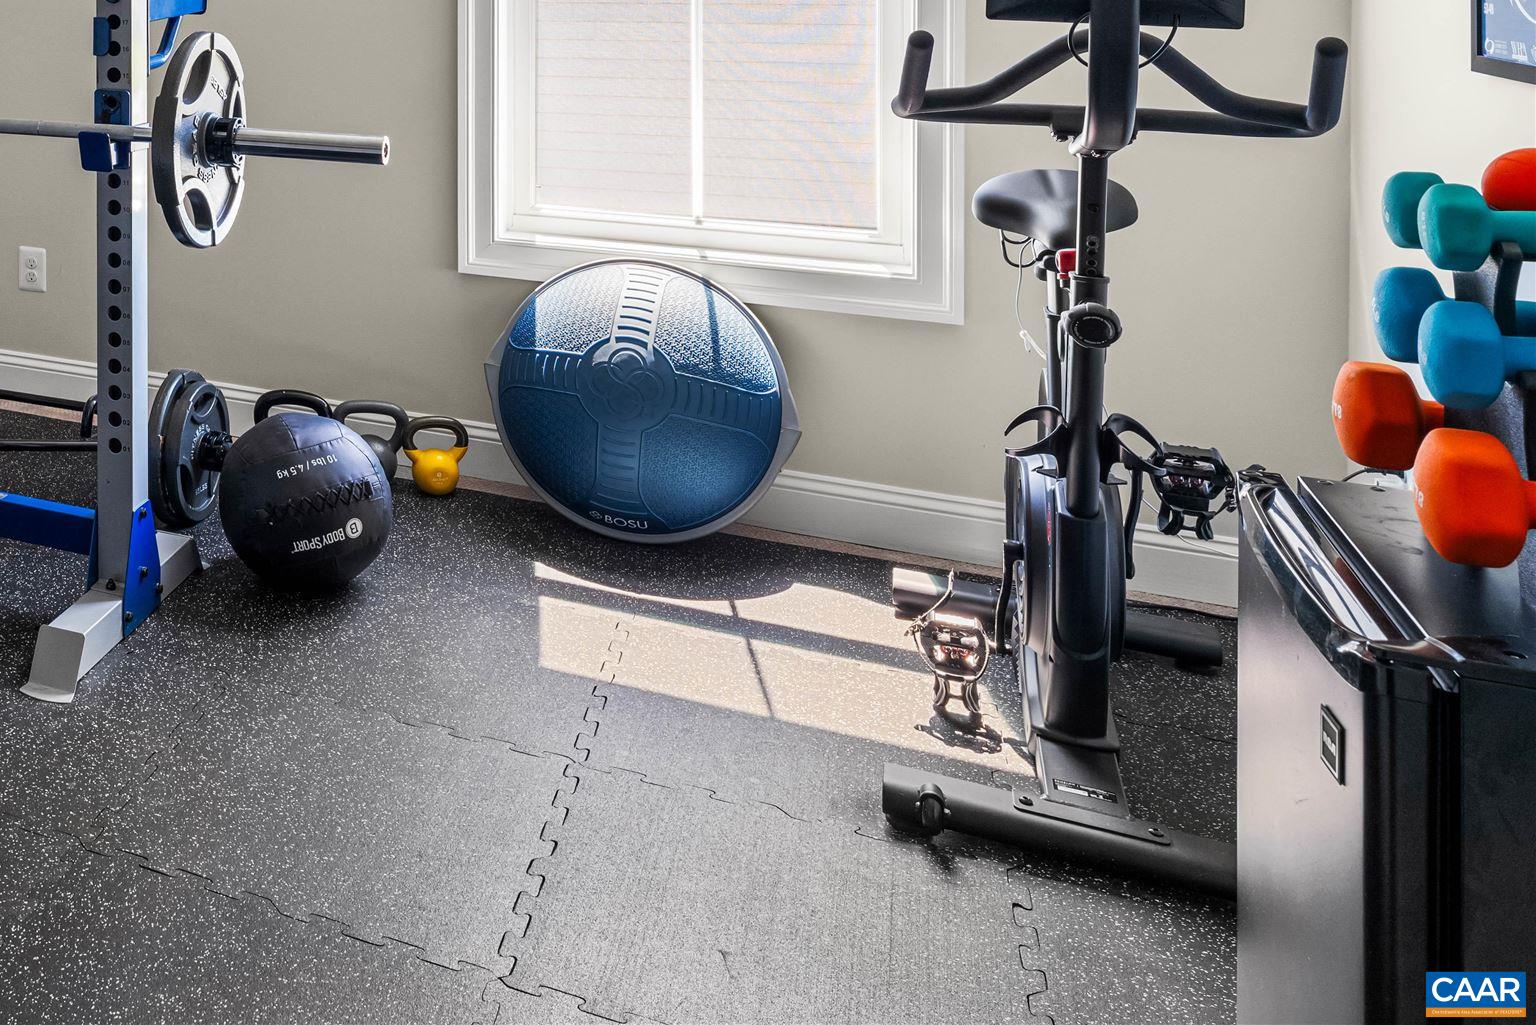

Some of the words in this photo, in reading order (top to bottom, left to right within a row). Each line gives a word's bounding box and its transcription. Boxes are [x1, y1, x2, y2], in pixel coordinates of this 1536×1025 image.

[311, 455, 327, 466] lbs
[326, 454, 338, 464] 10
[276, 469, 290, 479] kg
[289, 464, 304, 476] 4.5
[604, 514, 648, 530] BOSU
